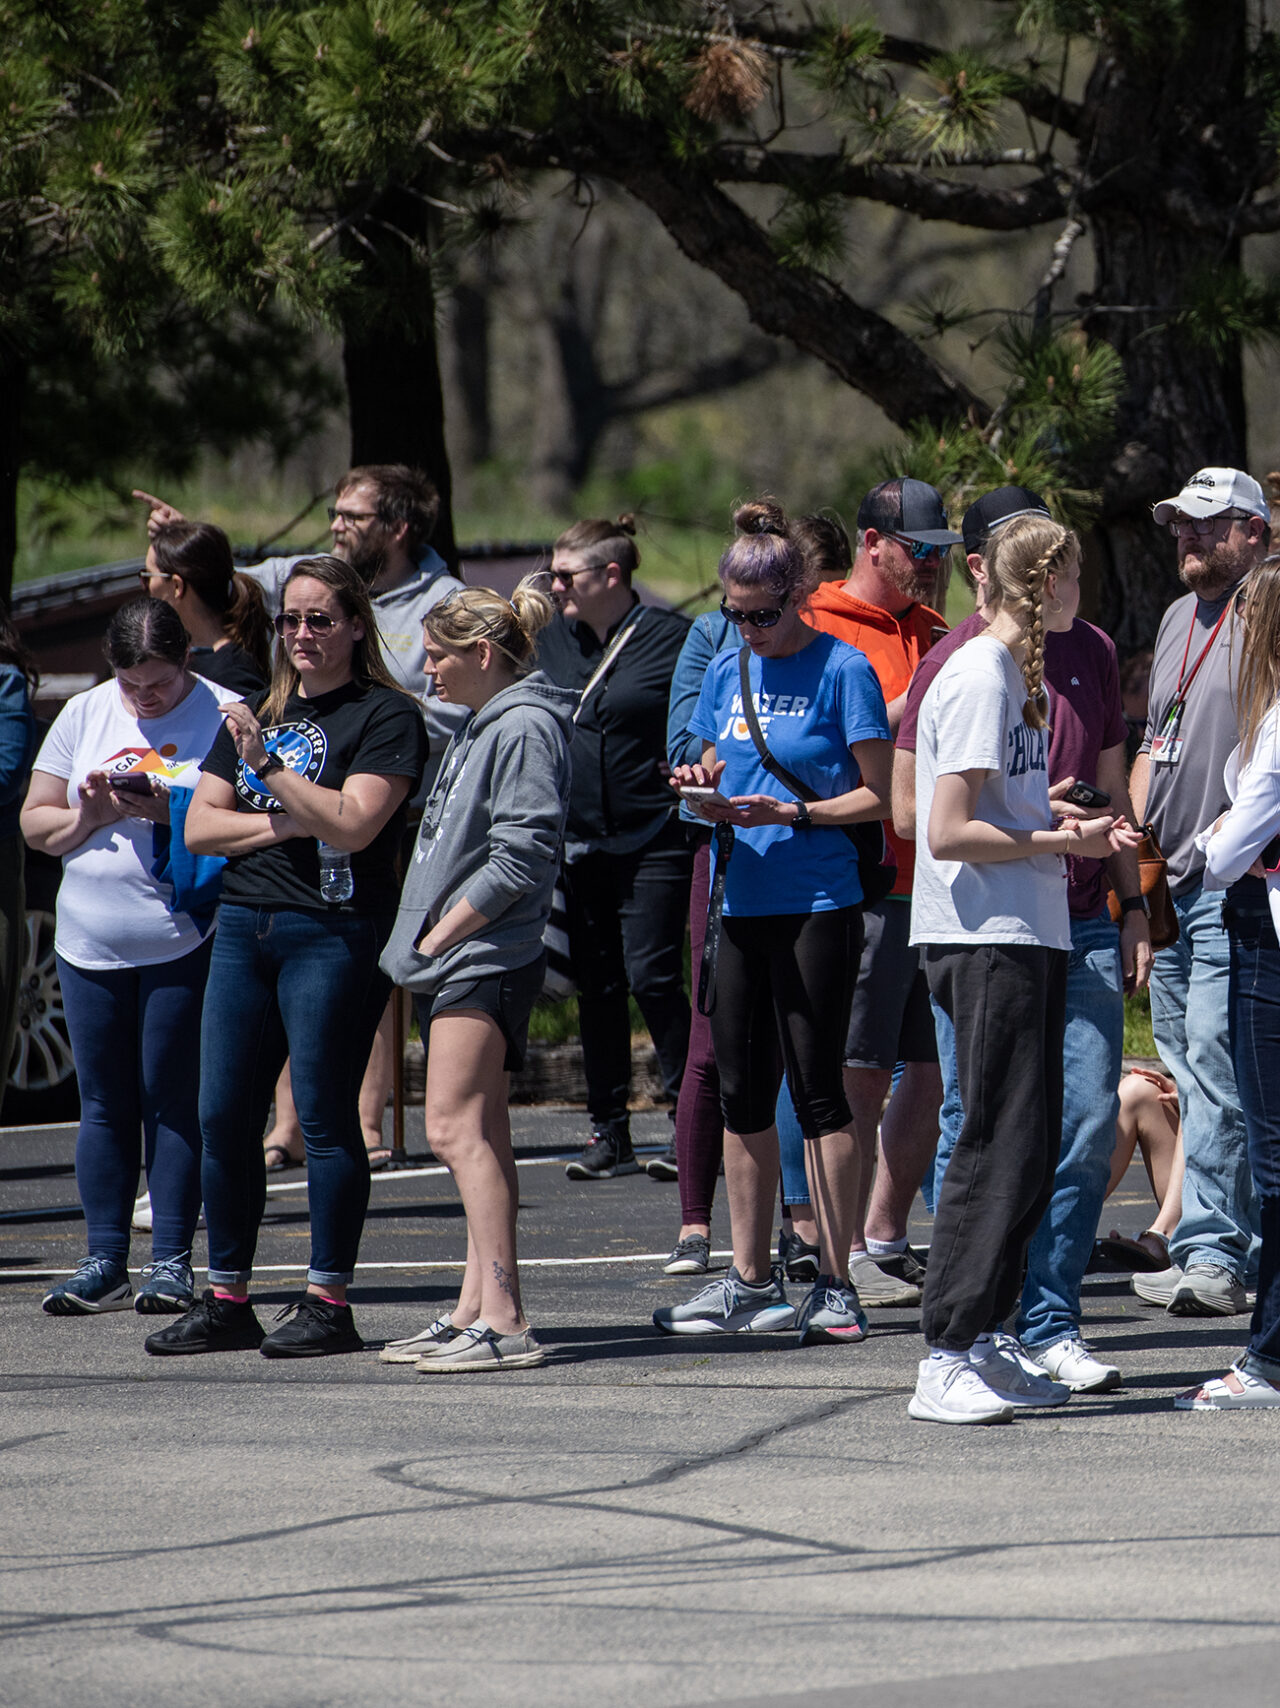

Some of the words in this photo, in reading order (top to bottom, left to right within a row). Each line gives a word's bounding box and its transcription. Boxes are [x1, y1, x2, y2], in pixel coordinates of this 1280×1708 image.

[731, 692, 809, 717] WATER
[289, 722, 324, 754] PPERS
[110, 756, 138, 775] GA
